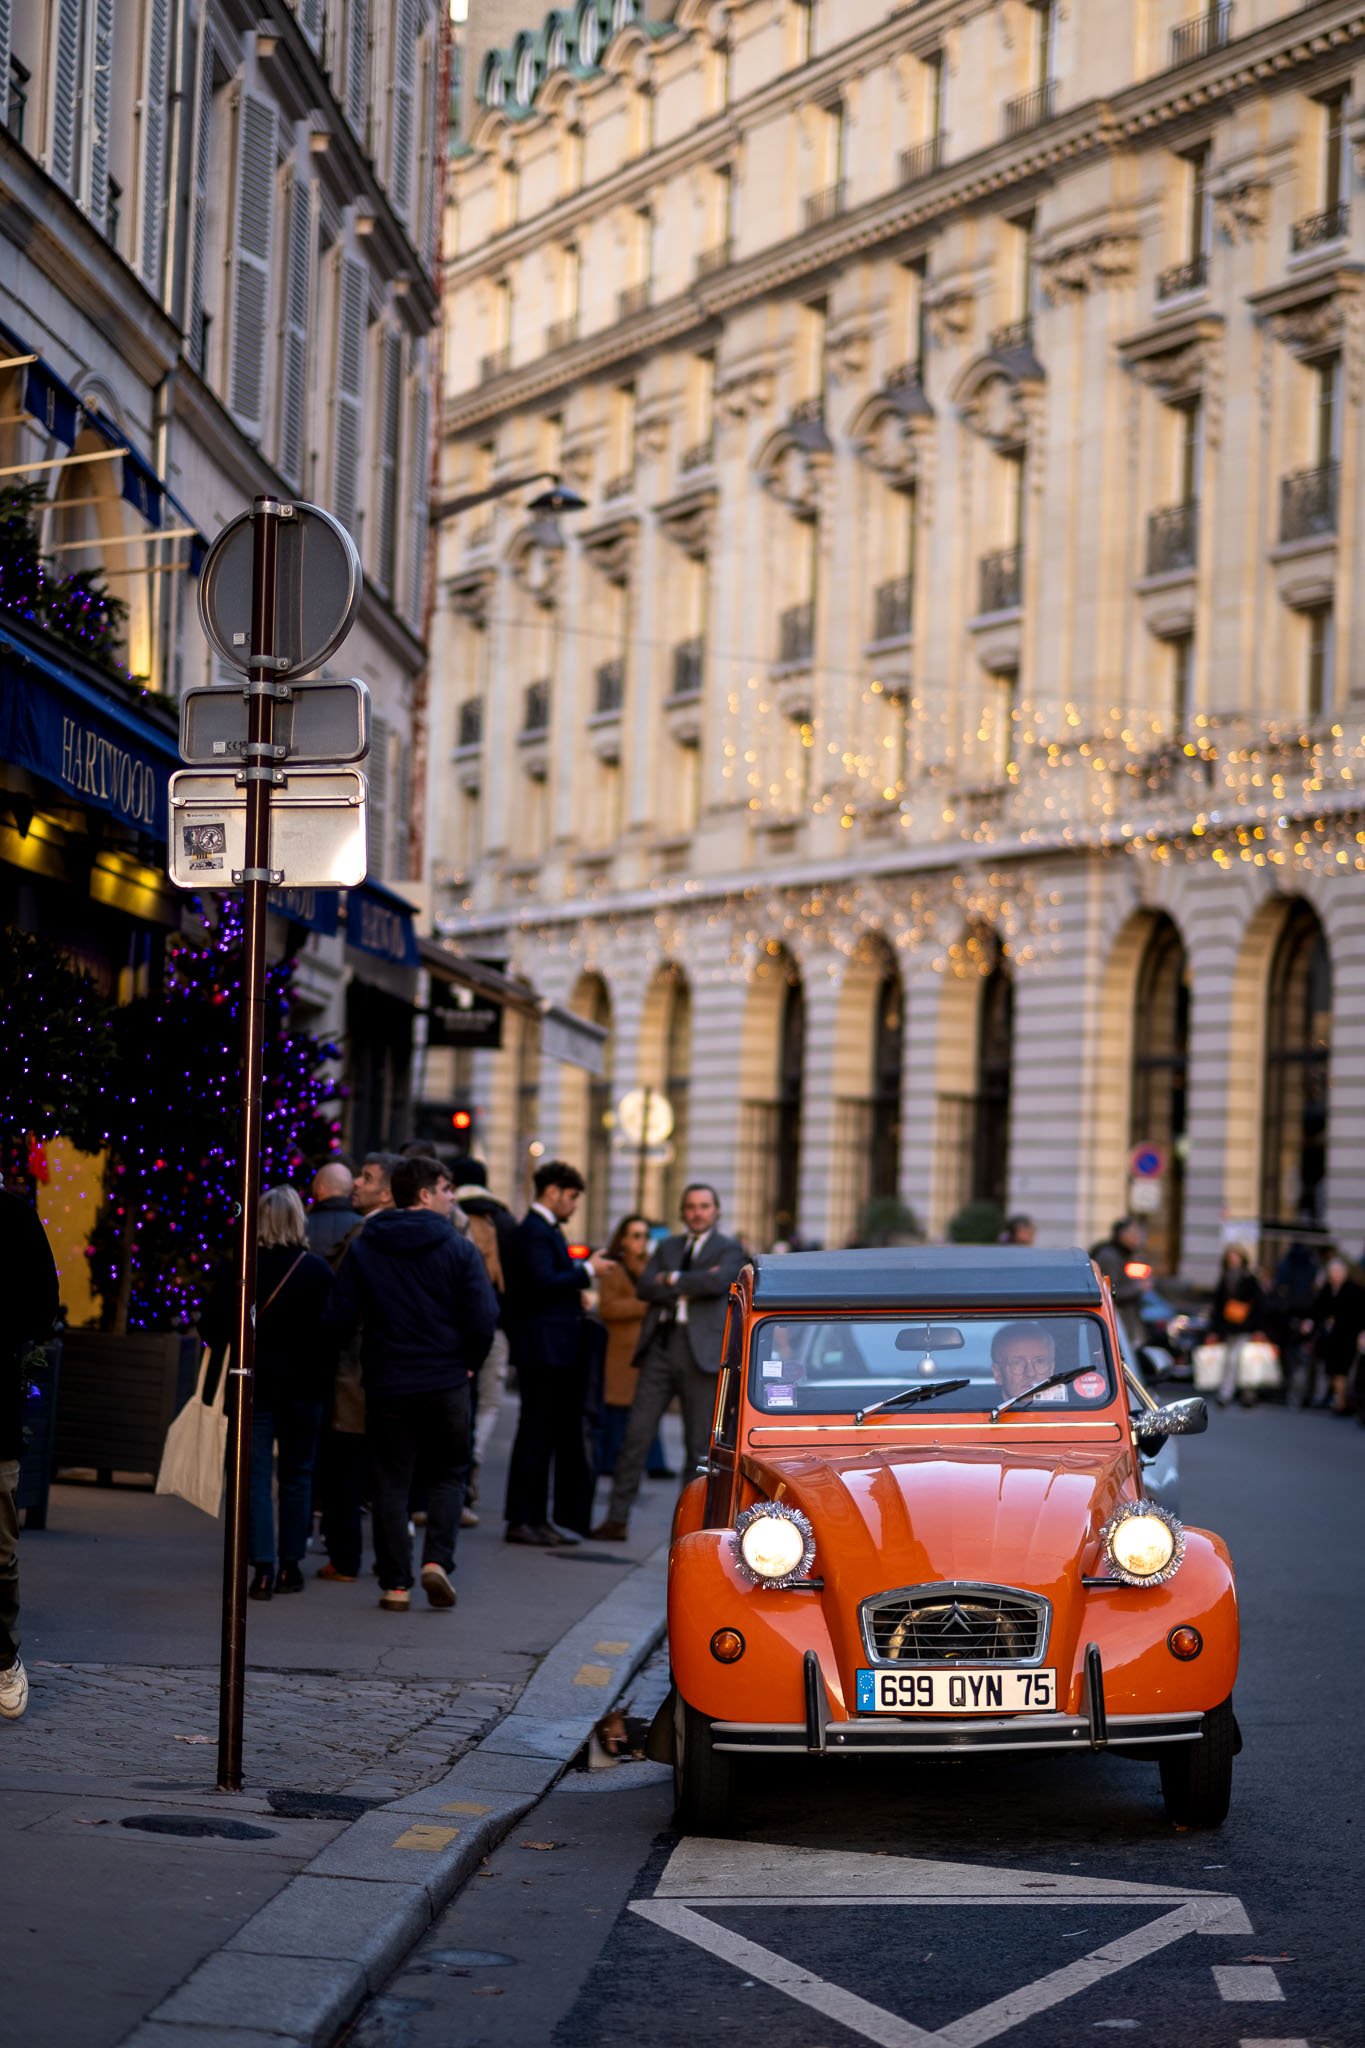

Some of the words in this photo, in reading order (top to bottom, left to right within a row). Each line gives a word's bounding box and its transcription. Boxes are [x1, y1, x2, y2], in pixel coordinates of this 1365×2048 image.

[61, 716, 155, 824] HARTWOOD
[863, 1693, 870, 1704] F
[880, 1675, 934, 1707] 699
[949, 1674, 1003, 1707] QYN
[1016, 1673, 1050, 1706] 75
